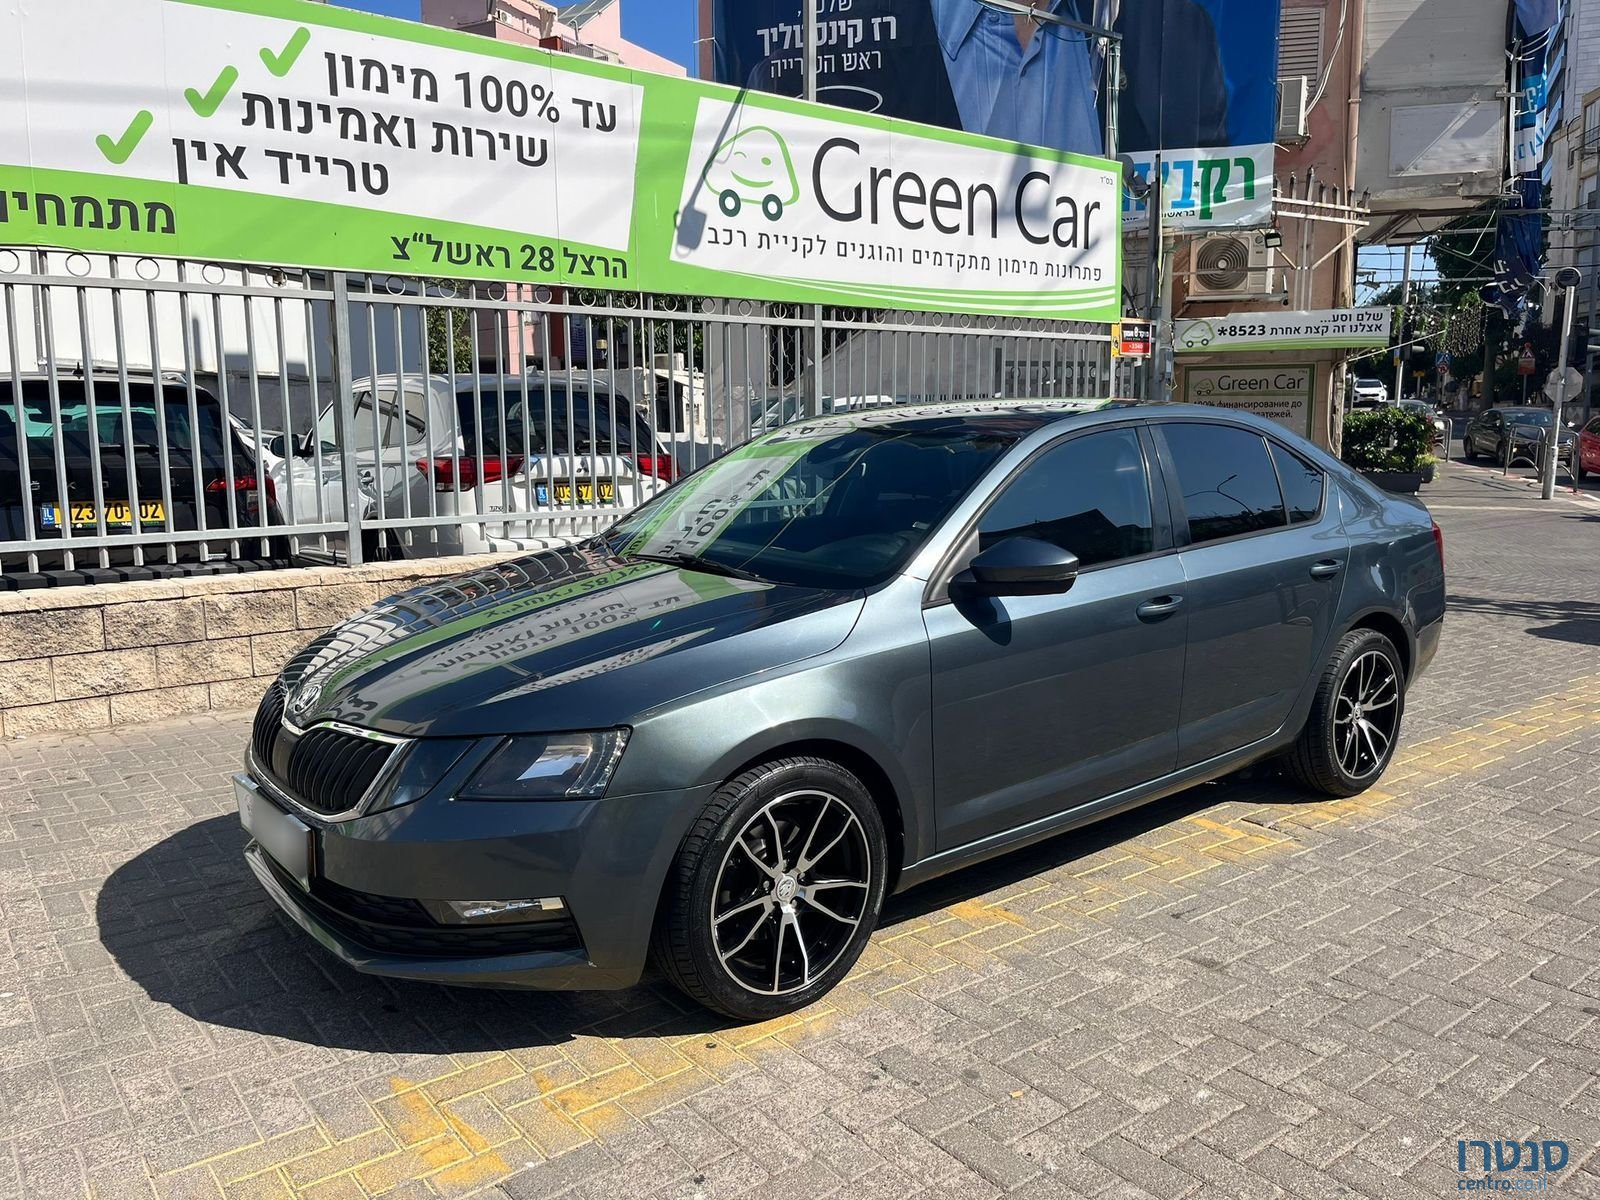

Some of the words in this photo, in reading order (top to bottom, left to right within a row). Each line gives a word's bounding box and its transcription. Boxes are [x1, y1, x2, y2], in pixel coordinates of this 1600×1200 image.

[871, 15, 897, 41] רז
[842, 50, 881, 72] ראש
[324, 51, 438, 103] מימון
[455, 72, 560, 123] 100%
[242, 92, 416, 149] ואמינות
[572, 98, 617, 133] עד
[431, 121, 548, 167] שירות
[172, 138, 249, 184] אין
[265, 149, 389, 195] טרייד
[812, 137, 998, 238] Green
[1015, 171, 1100, 249] Car
[707, 227, 747, 248] רכב
[758, 230, 826, 259] לקניית
[520, 244, 555, 272] 28
[563, 247, 627, 279] הרצל
[836, 241, 903, 263] והוגנים
[912, 249, 990, 272] מתקדמים
[998, 257, 1038, 277] מימון
[1045, 262, 1102, 282] פתרונות
[1350, 322, 1382, 333] אצלנו
[1357, 311, 1383, 322] שלם
[1270, 326, 1301, 336] אחרת
[1305, 325, 1330, 336] קצת
[1333, 324, 1346, 333] זה
[1217, 375, 1269, 391] Green
[1274, 374, 1305, 390] Car
[1216, 400, 1290, 410] финансирование
[1291, 401, 1302, 409] до
